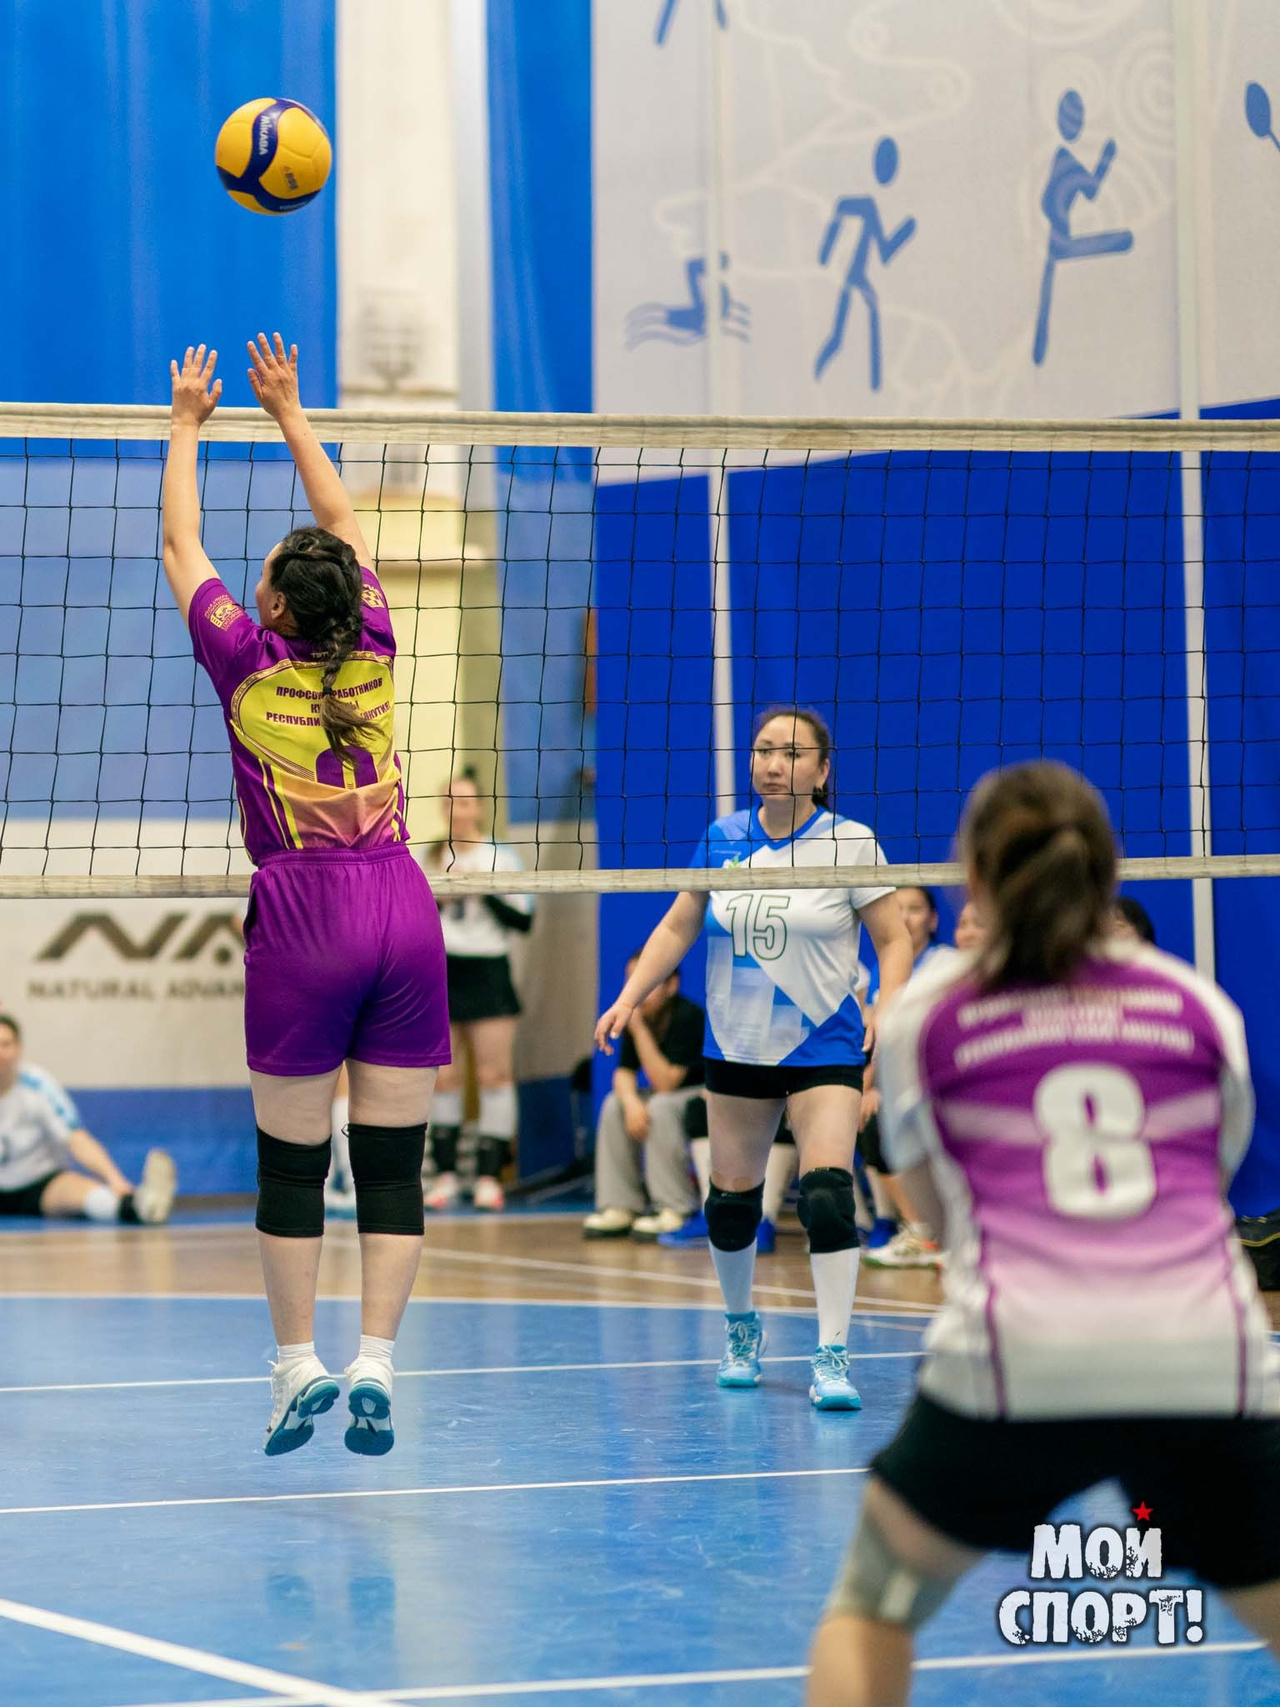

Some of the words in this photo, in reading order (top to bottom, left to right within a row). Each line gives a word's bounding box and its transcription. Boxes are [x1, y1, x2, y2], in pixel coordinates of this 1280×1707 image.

[266, 711, 321, 727] РЕСПУБЛИ
[725, 893, 791, 961] 15
[1033, 1062, 1157, 1218] 8
